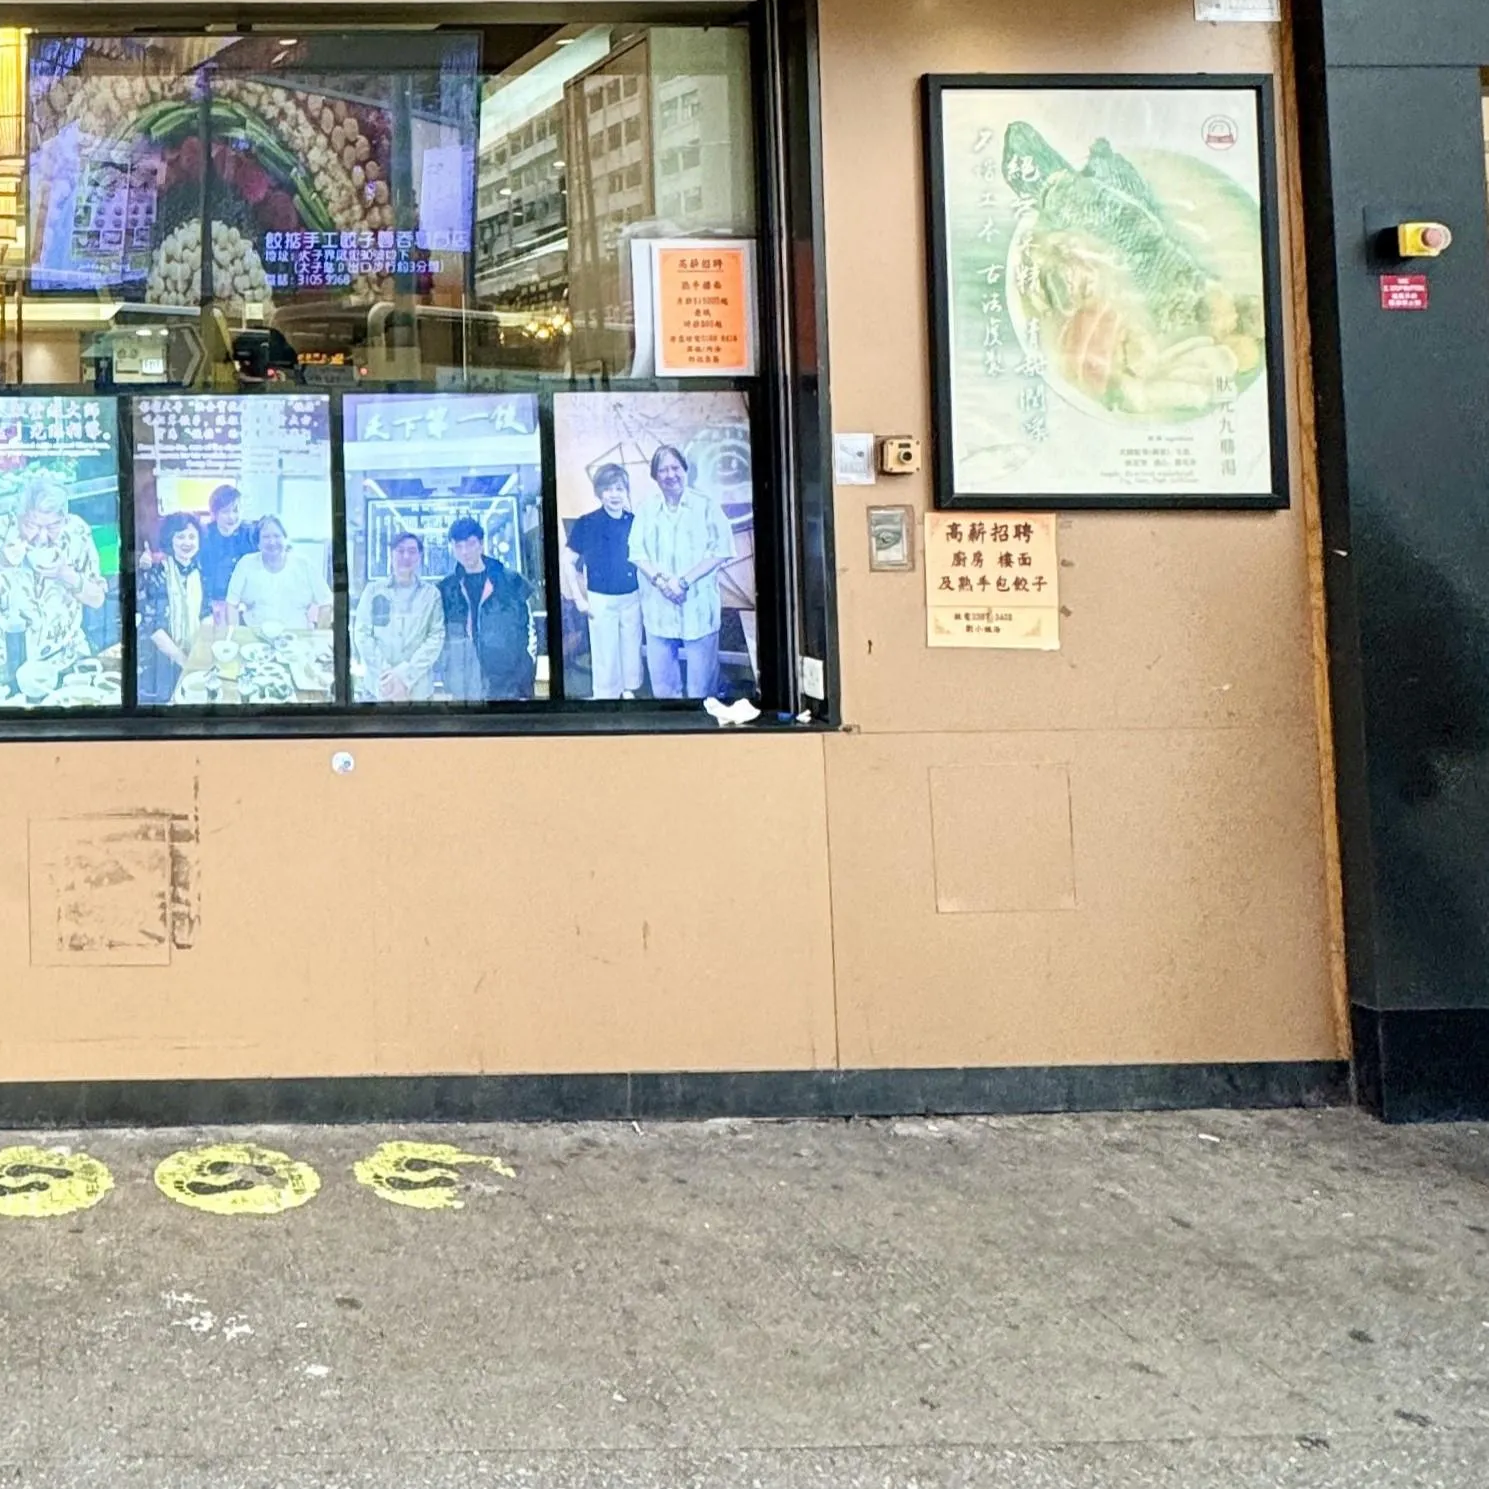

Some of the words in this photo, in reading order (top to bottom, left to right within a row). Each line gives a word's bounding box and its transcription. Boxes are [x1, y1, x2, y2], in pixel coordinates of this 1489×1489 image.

[945, 522, 1034, 544] 高薪招聘
[952, 550, 984, 568] 廚房
[997, 551, 1032, 568] 樓面
[938, 575, 1048, 592] 及熟手包餃子
